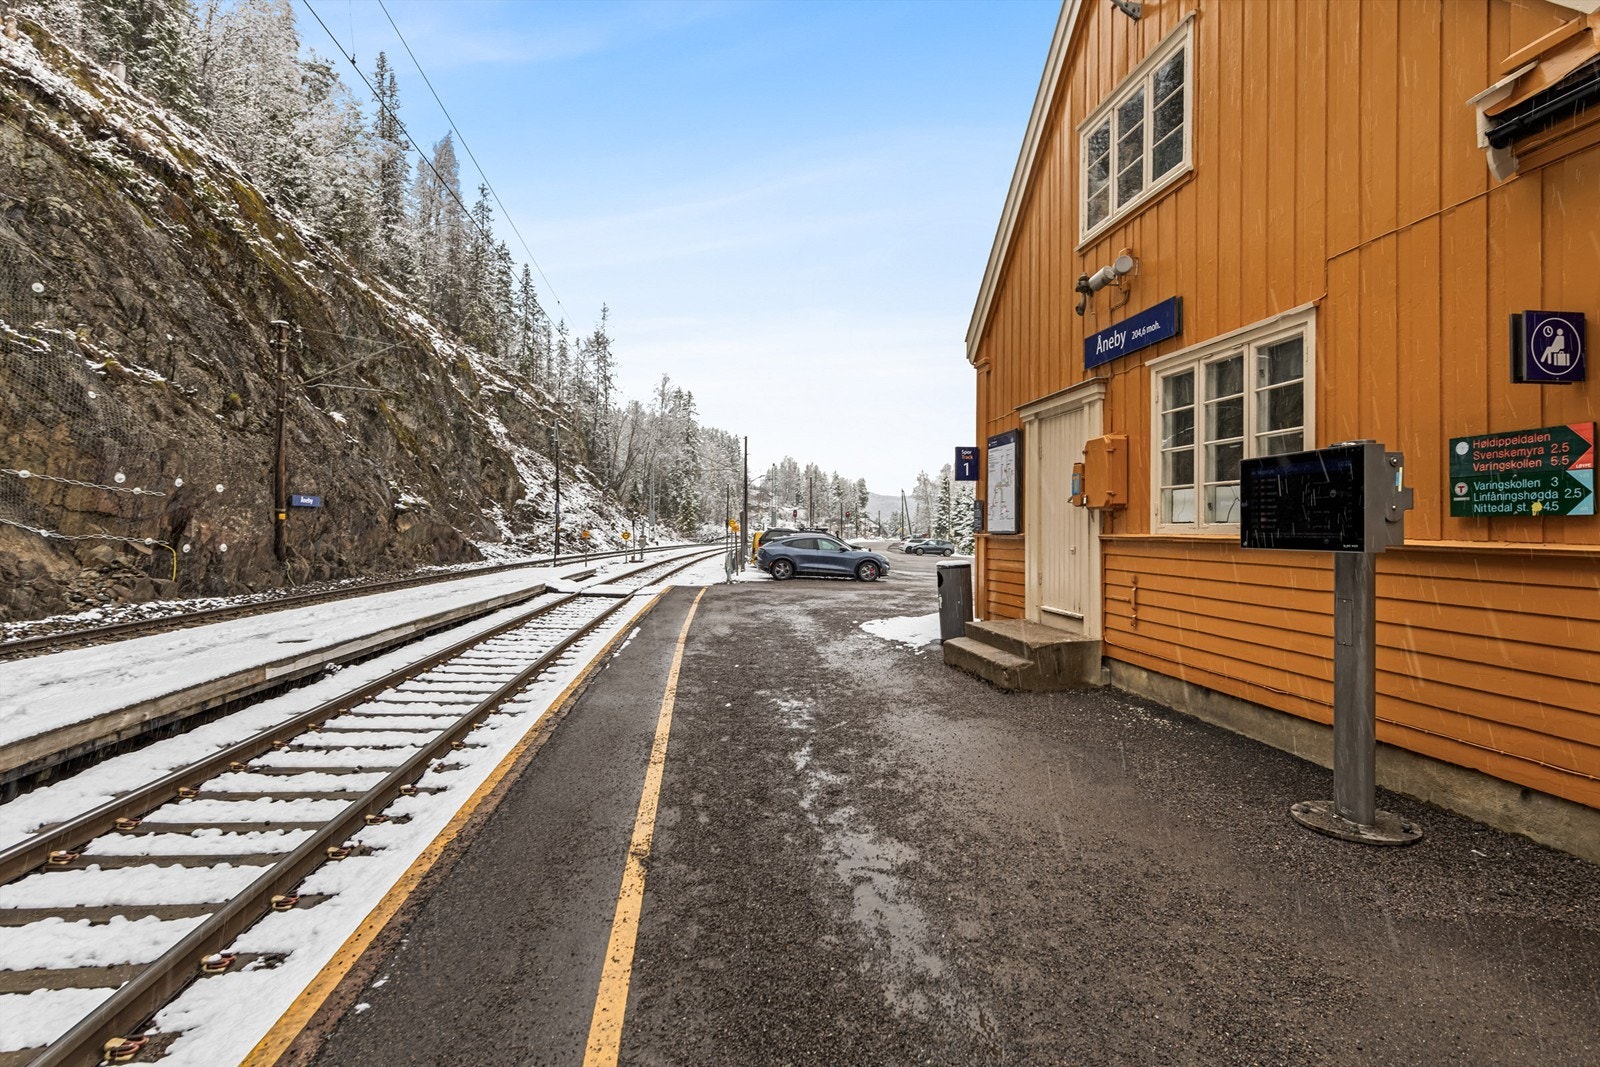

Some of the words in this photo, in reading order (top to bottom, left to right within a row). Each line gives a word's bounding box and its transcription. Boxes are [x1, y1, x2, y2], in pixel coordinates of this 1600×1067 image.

[1096, 330, 1127, 355] Åneby
[1472, 433, 1551, 448] Høldippeldalen
[1473, 445, 1545, 460] Svenskemyra
[1550, 442, 1570, 454] 2.5
[963, 462, 969, 476] 1
[1472, 459, 1542, 472] Varingskollen
[1550, 455, 1570, 466] 5.5
[1457, 485, 1465, 494] T
[1473, 479, 1541, 492] Varingskollen
[1550, 476, 1559, 487] 3
[1473, 489, 1559, 503] Linfåningshøgda
[1564, 488, 1582, 499] 2.5
[1473, 502, 1513, 513] Nittedal
[1516, 504, 1529, 512] st.
